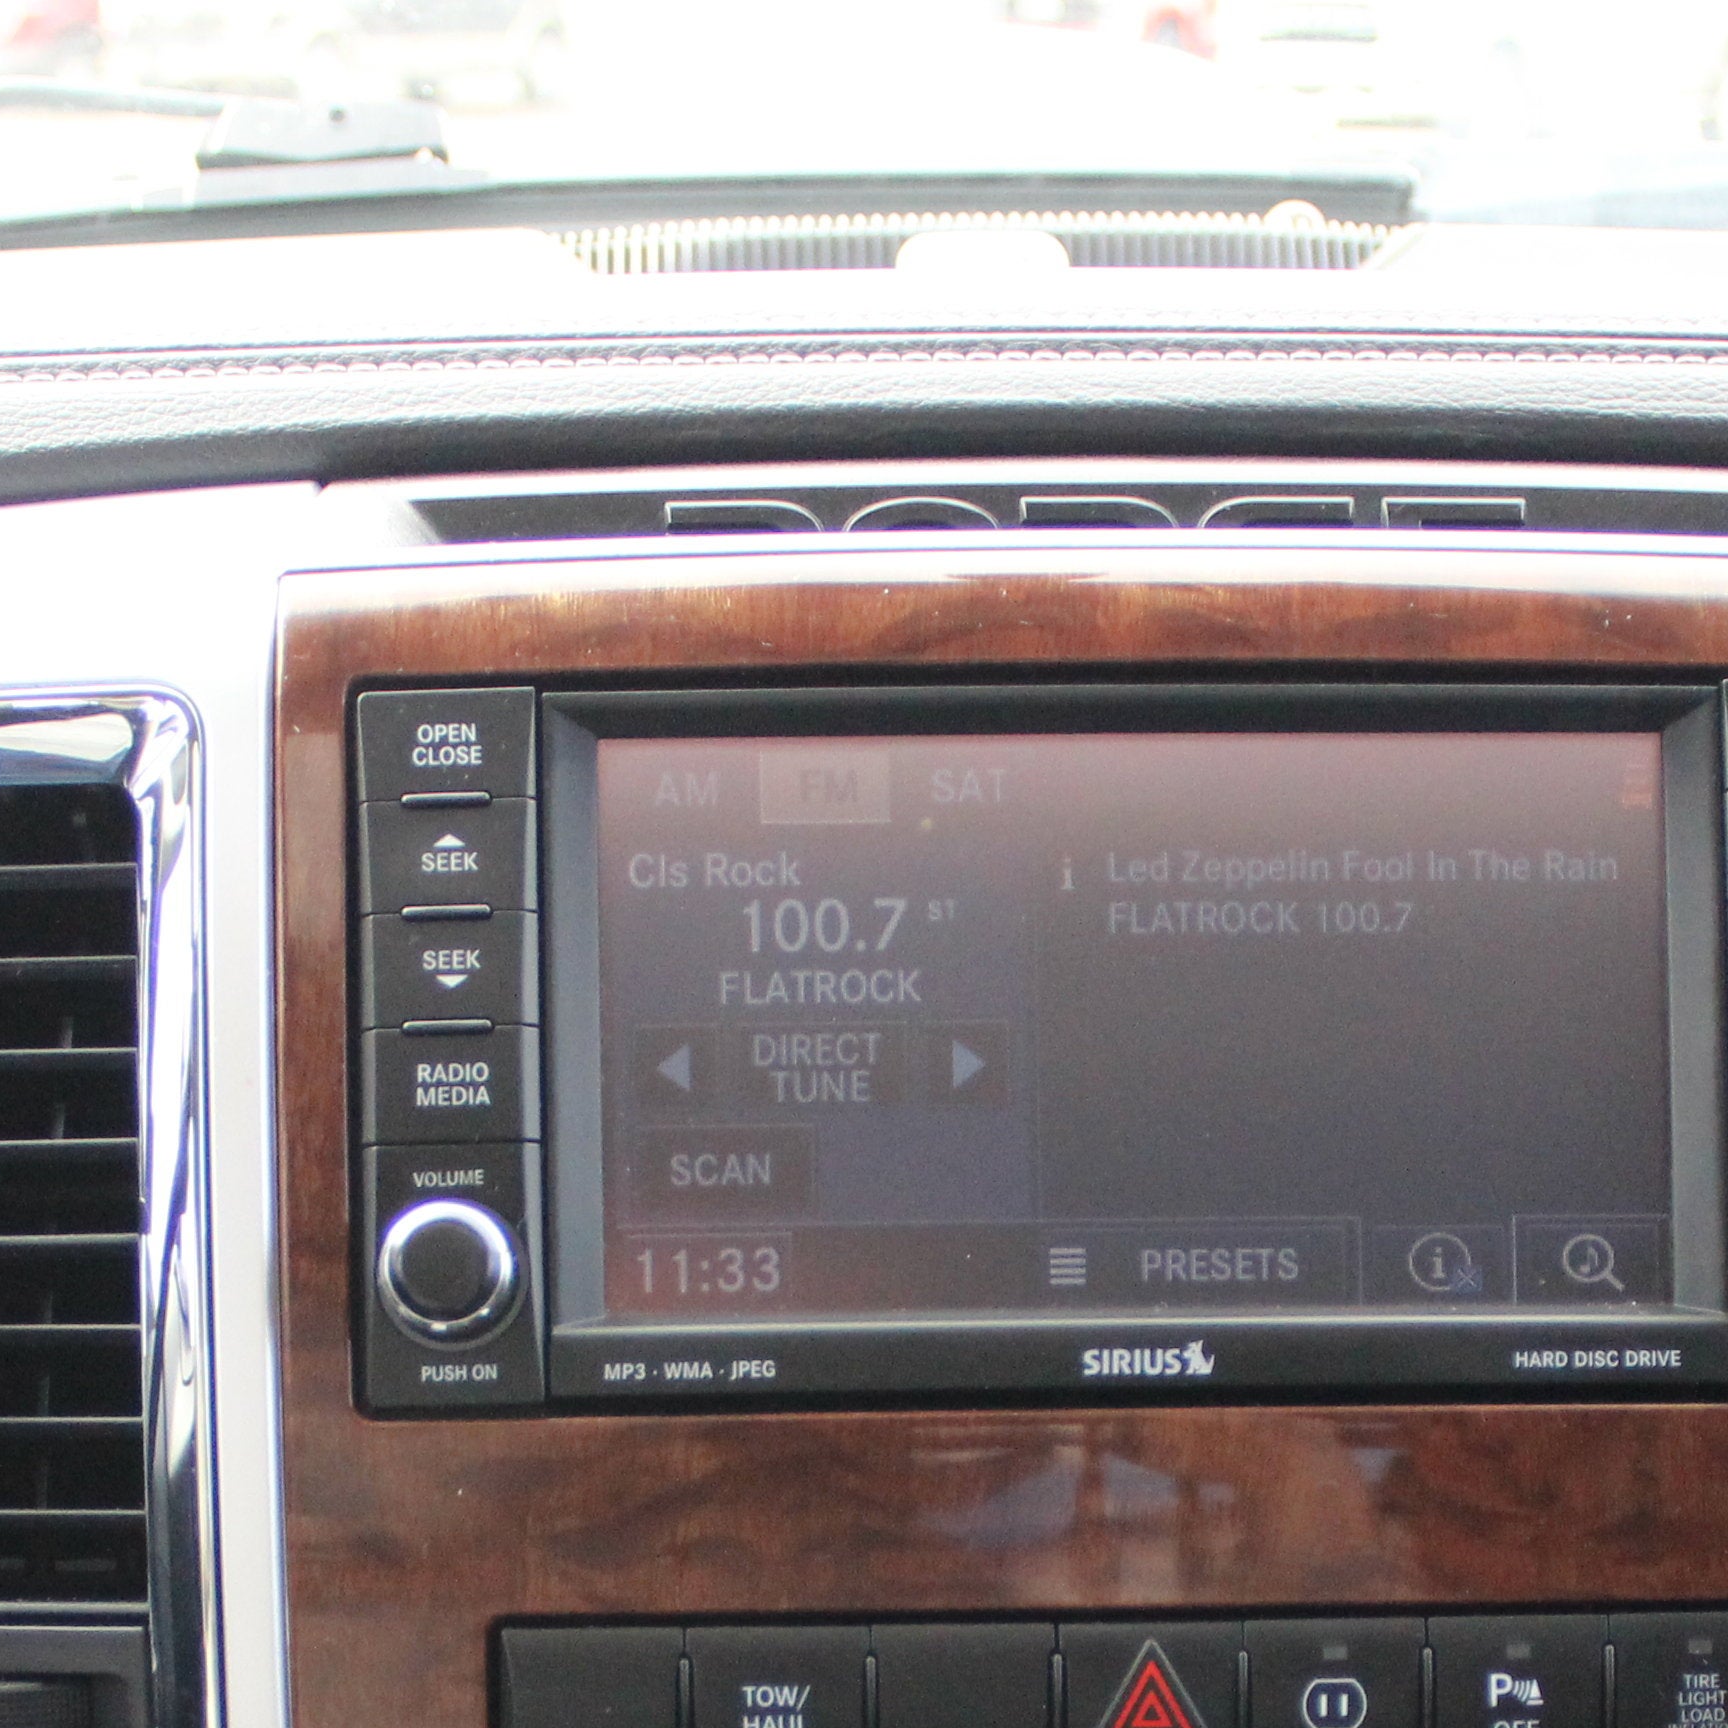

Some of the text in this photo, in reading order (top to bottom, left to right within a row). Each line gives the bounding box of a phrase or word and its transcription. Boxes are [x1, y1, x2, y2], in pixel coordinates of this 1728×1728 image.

[417, 724, 477, 743] OPEN
[412, 744, 483, 766] CLOSE
[655, 771, 720, 807] AM
[931, 767, 1006, 803] SAT
[421, 852, 479, 873] SEEK
[705, 852, 802, 887] Rock
[1108, 851, 1169, 882] Led
[1181, 850, 1329, 891] Zeppelin
[1343, 849, 1414, 882] Fool
[1468, 848, 1531, 881] The
[1544, 848, 1618, 881] Rain
[743, 898, 907, 952] 100.7
[1109, 900, 1412, 934] FLATROCK 100.7
[422, 949, 481, 970] SEEK
[719, 968, 923, 1004] FLATROCK
[753, 1031, 882, 1067] DIRECT
[416, 1062, 490, 1084] RADIO
[415, 1084, 491, 1107] MEDIA
[771, 1069, 871, 1103] TUNE
[413, 1168, 485, 1188] VOLUME
[670, 1154, 771, 1186] SCAN
[636, 1248, 782, 1293] 11:33
[1141, 1248, 1299, 1282] PRESETS
[604, 1359, 776, 1380] MP3 WMA JPEG
[1082, 1348, 1182, 1376] SIRIUS
[1514, 1349, 1682, 1368] HARD DISC DRIVE
[421, 1363, 498, 1383] PUSH ON
[1683, 1673, 1720, 1689] TIRE
[742, 1685, 811, 1710] TOW/
[1677, 1689, 1728, 1706] LIGHT
[1681, 1707, 1726, 1723] LOAD
